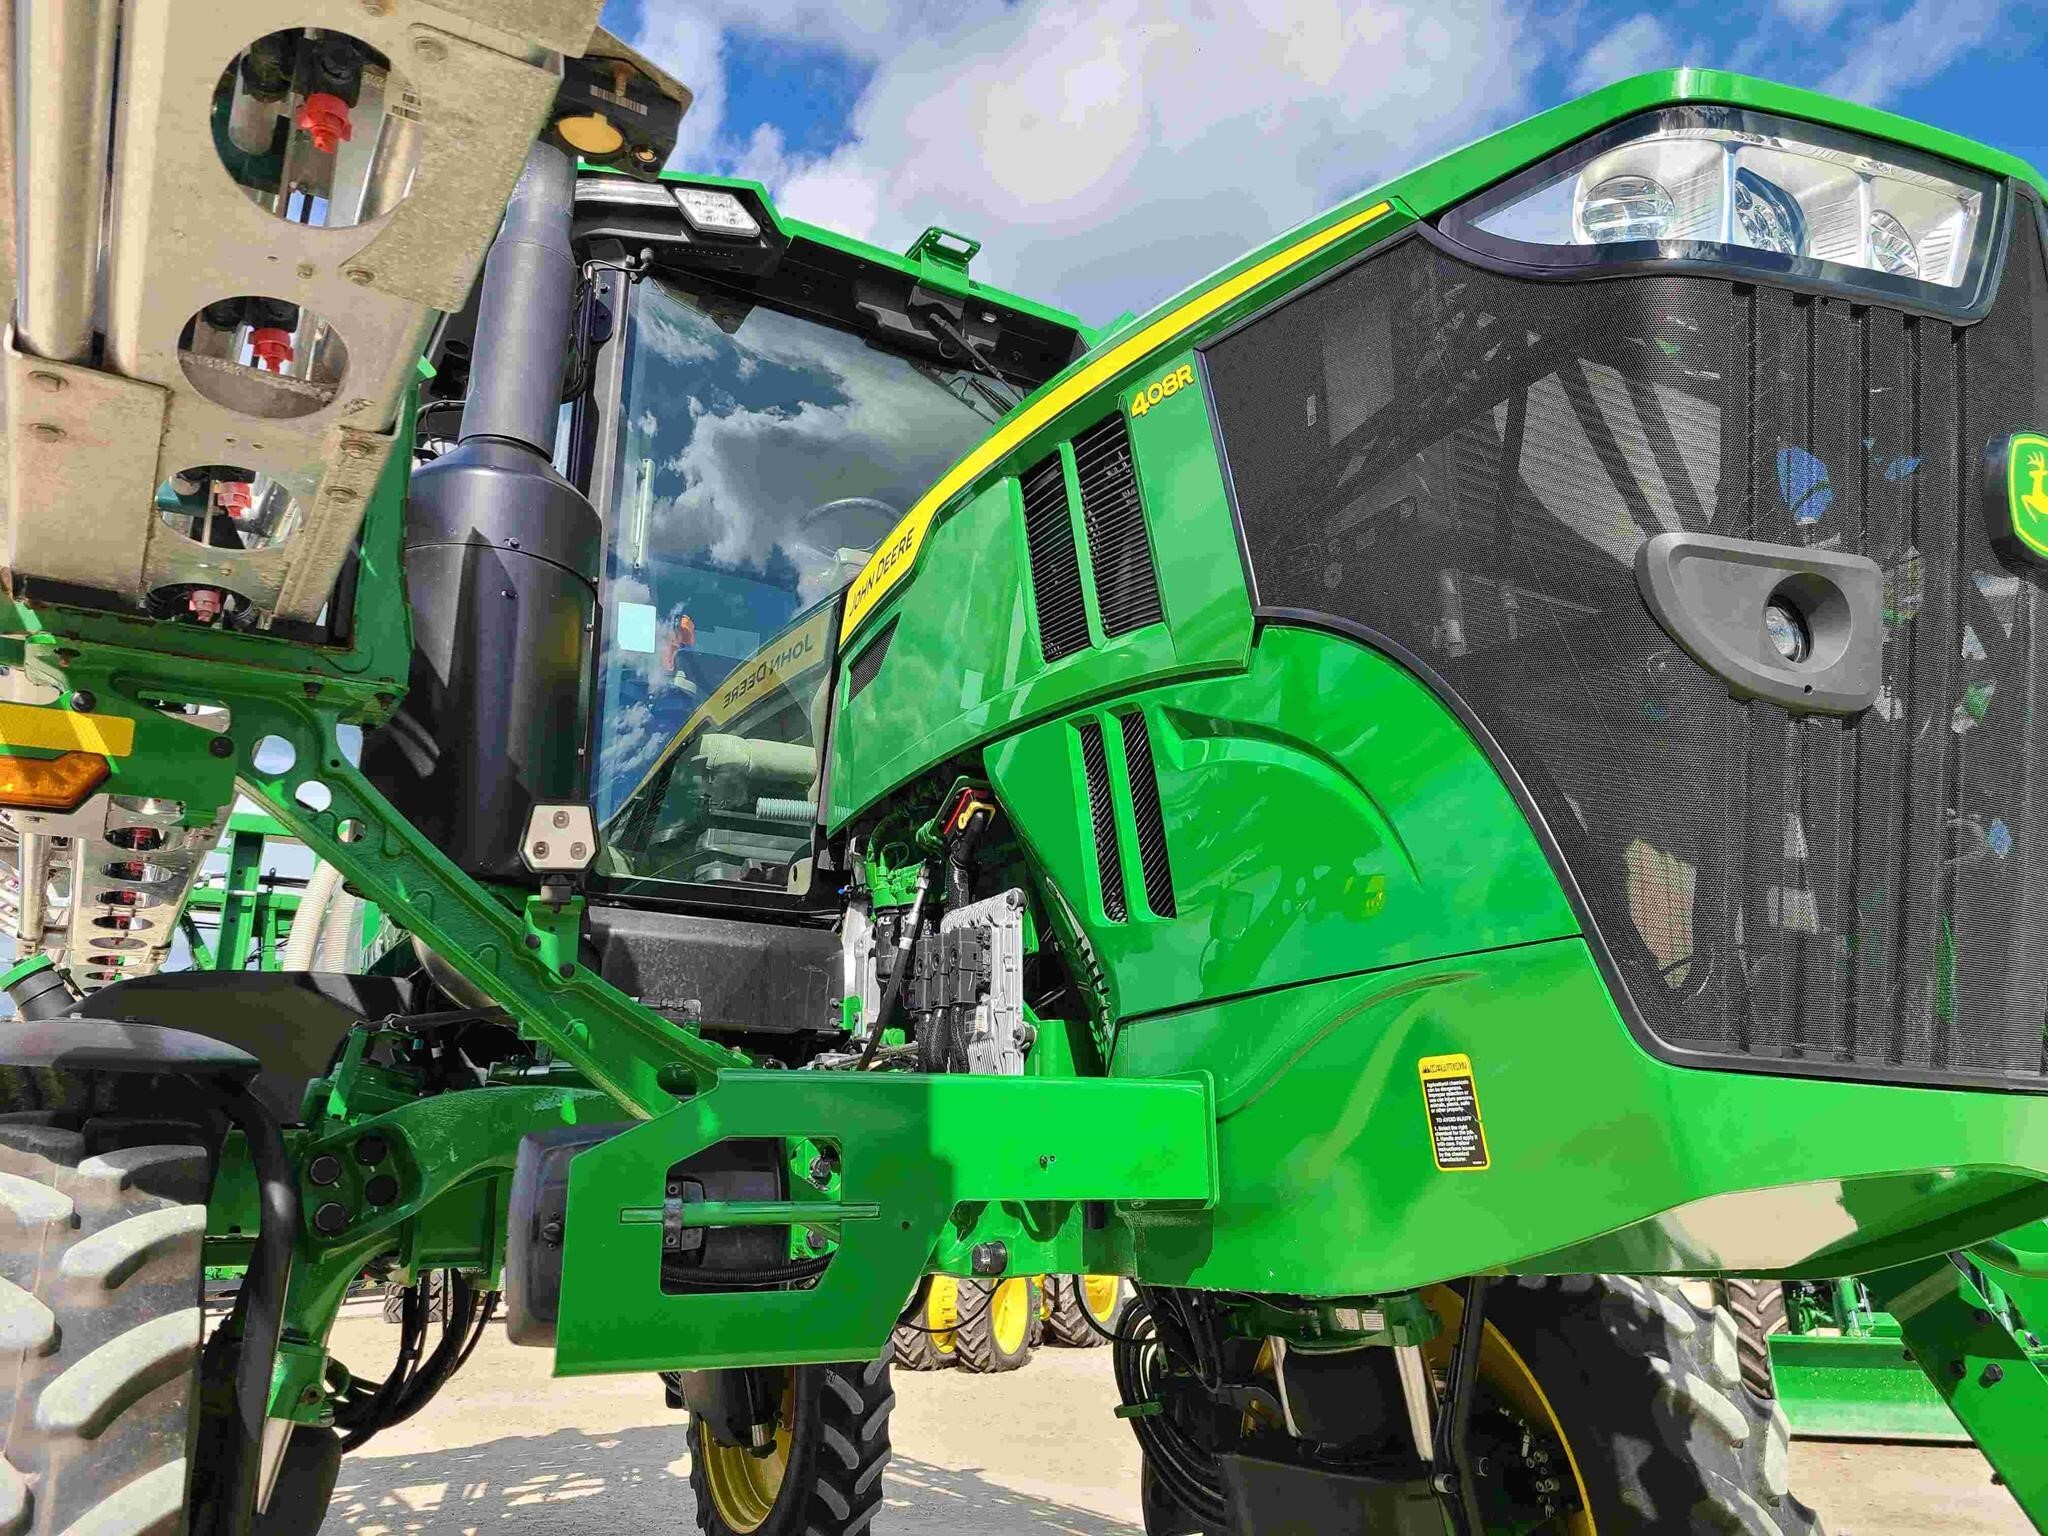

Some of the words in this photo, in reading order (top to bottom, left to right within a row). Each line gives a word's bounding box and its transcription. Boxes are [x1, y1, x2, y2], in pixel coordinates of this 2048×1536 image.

[1131, 364, 1194, 418] 408R
[848, 578, 875, 617] JOHN
[874, 527, 915, 584] DEERE
[1430, 1062, 1467, 1073] CAUTION
